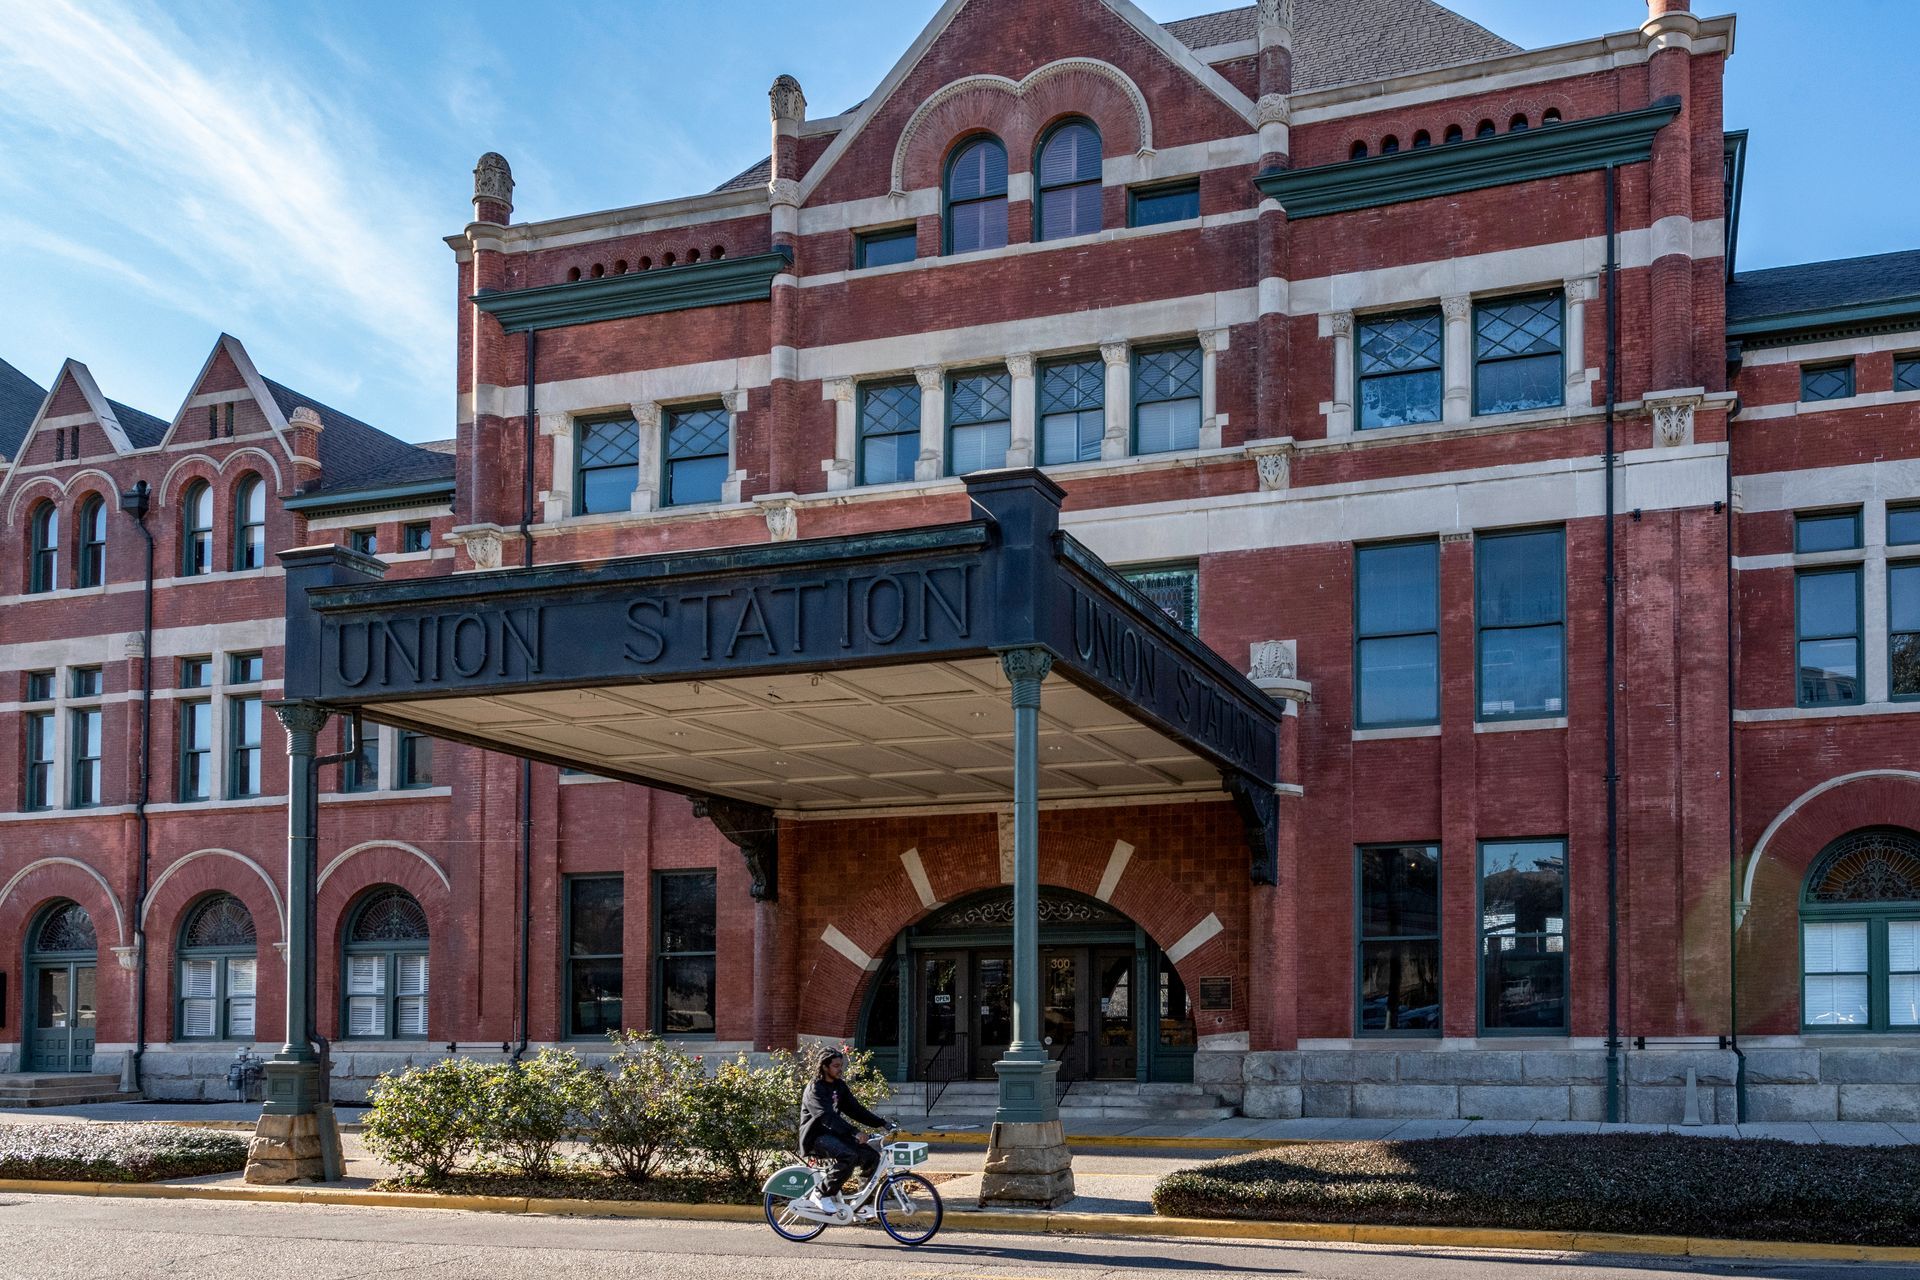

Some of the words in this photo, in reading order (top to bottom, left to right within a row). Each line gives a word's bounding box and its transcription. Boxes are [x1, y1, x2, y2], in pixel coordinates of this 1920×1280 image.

[335, 606, 543, 688] UNION
[622, 564, 977, 664] STATION
[1071, 586, 1158, 704] UNION
[1177, 663, 1258, 769] STATION
[1051, 959, 1070, 969] 300
[935, 995, 950, 1003] OPEN
